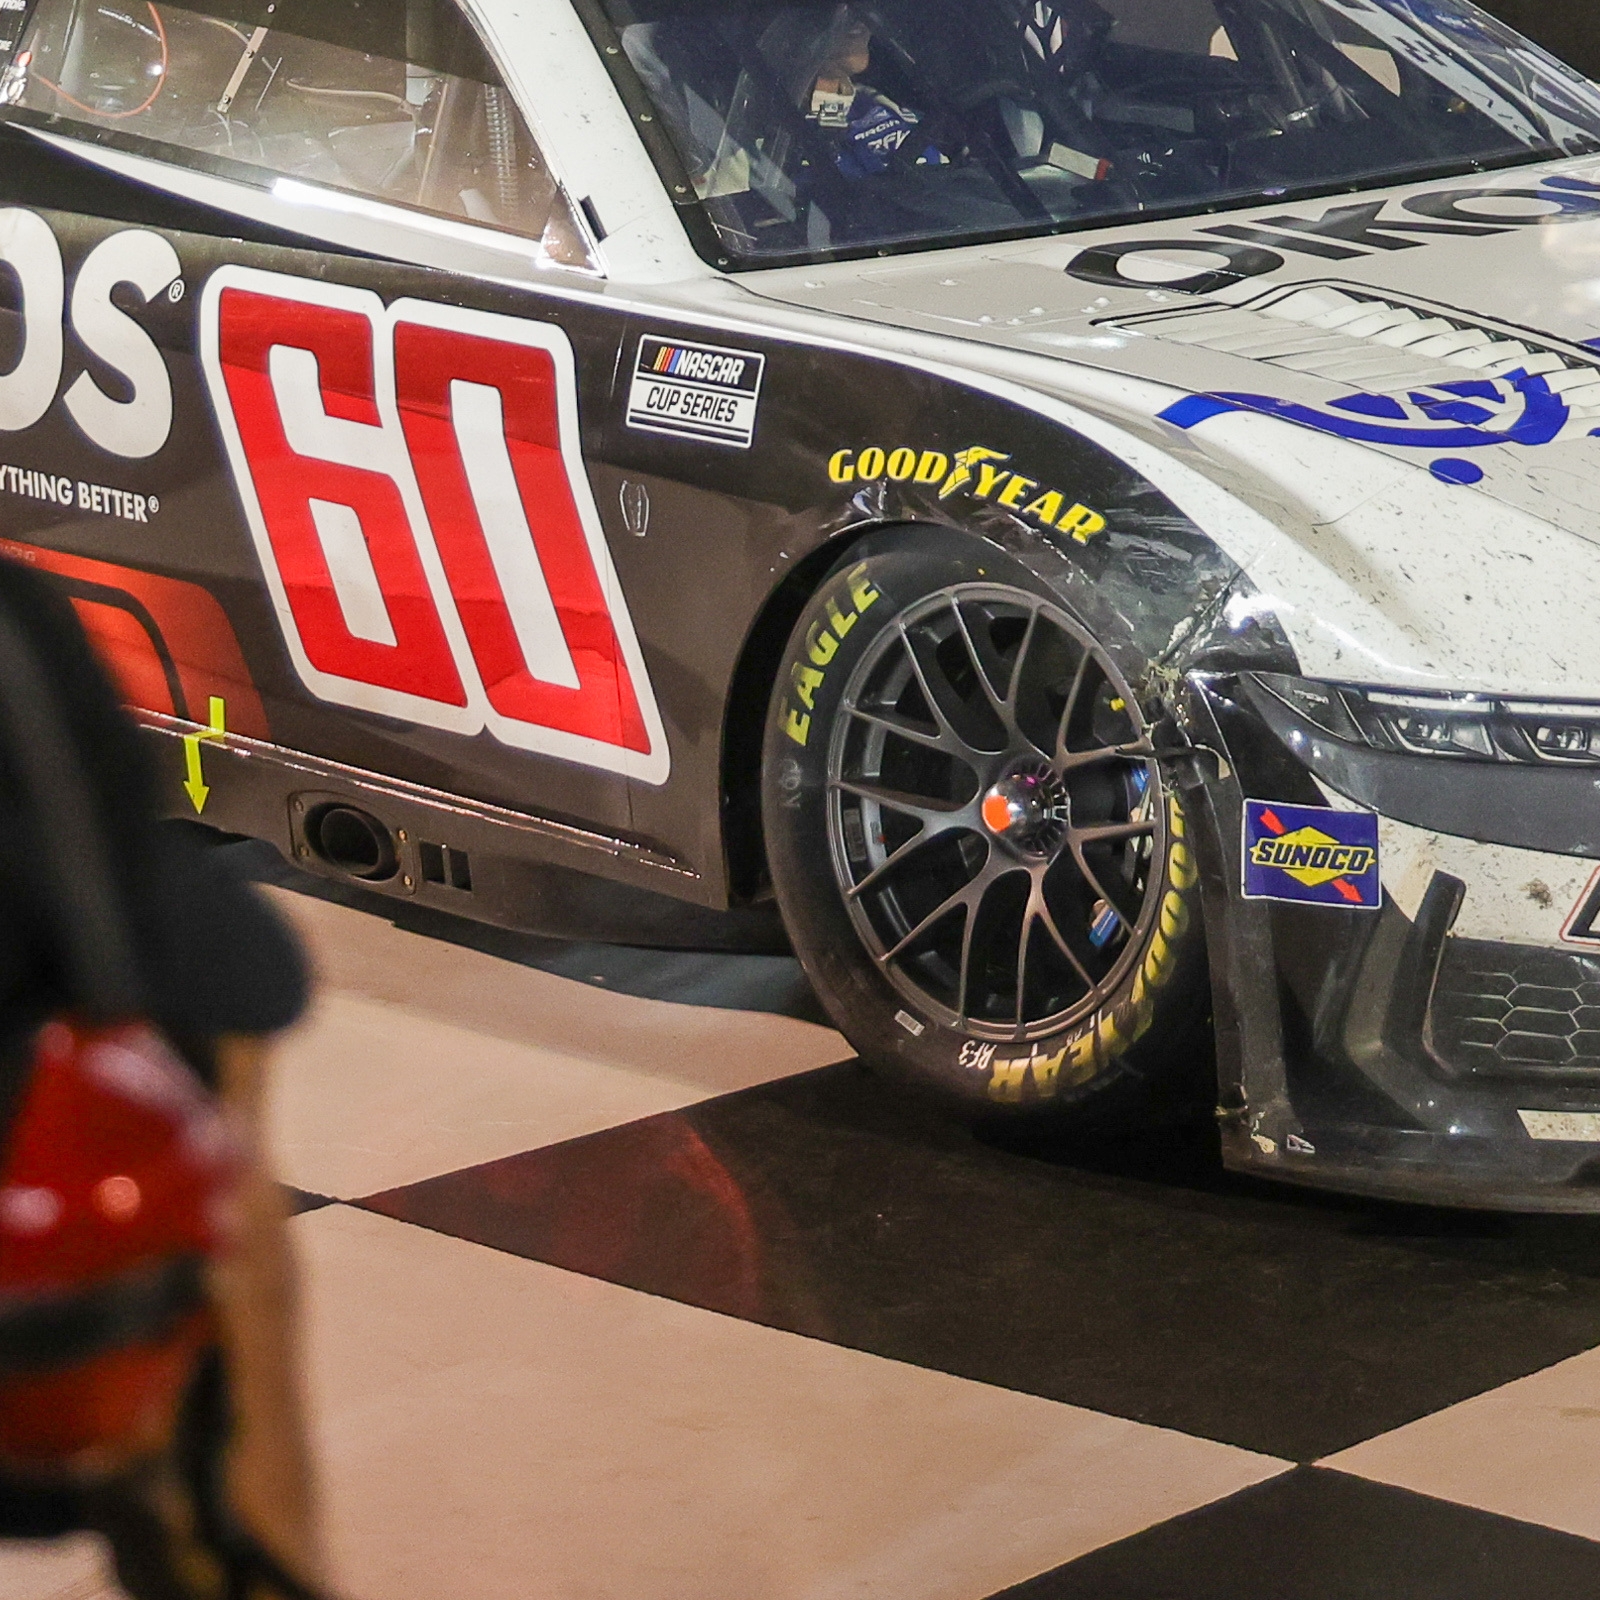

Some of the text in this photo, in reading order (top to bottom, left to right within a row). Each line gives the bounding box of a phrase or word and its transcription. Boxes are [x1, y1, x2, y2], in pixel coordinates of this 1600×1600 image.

[673, 349, 746, 386] NASCAR
[646, 385, 739, 424] CUP SERIES
[219, 285, 651, 758] 60
[777, 560, 882, 748] EAGLE
[1251, 837, 1373, 877] SUNOCO
